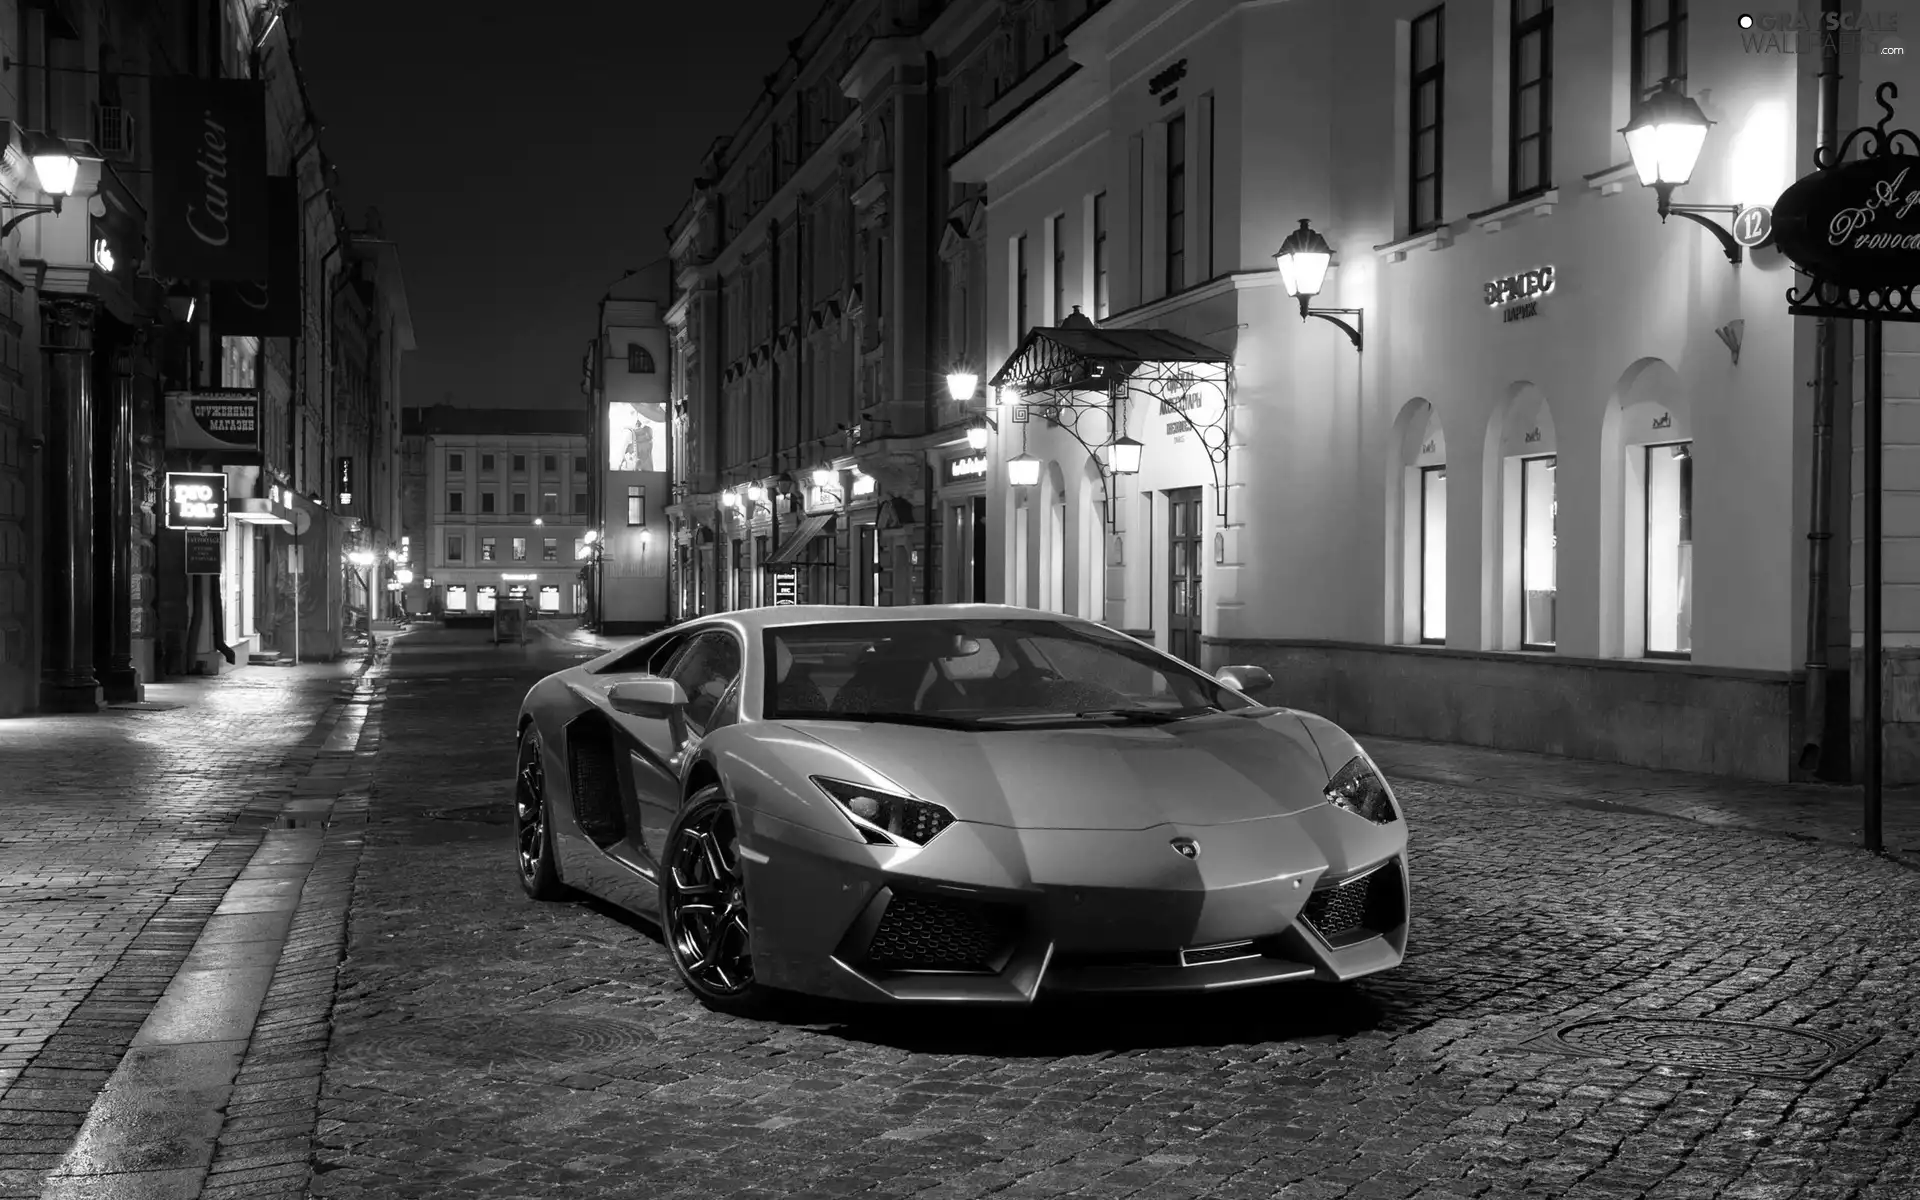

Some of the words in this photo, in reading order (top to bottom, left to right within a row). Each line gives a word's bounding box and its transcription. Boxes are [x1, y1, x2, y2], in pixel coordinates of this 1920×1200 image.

[186, 110, 229, 246] Cartier
[1744, 211, 1762, 240] 12
[1483, 265, 1555, 307] ЭРМЕС
[210, 419, 254, 431] МАГАЗИН
[174, 485, 213, 503] pro
